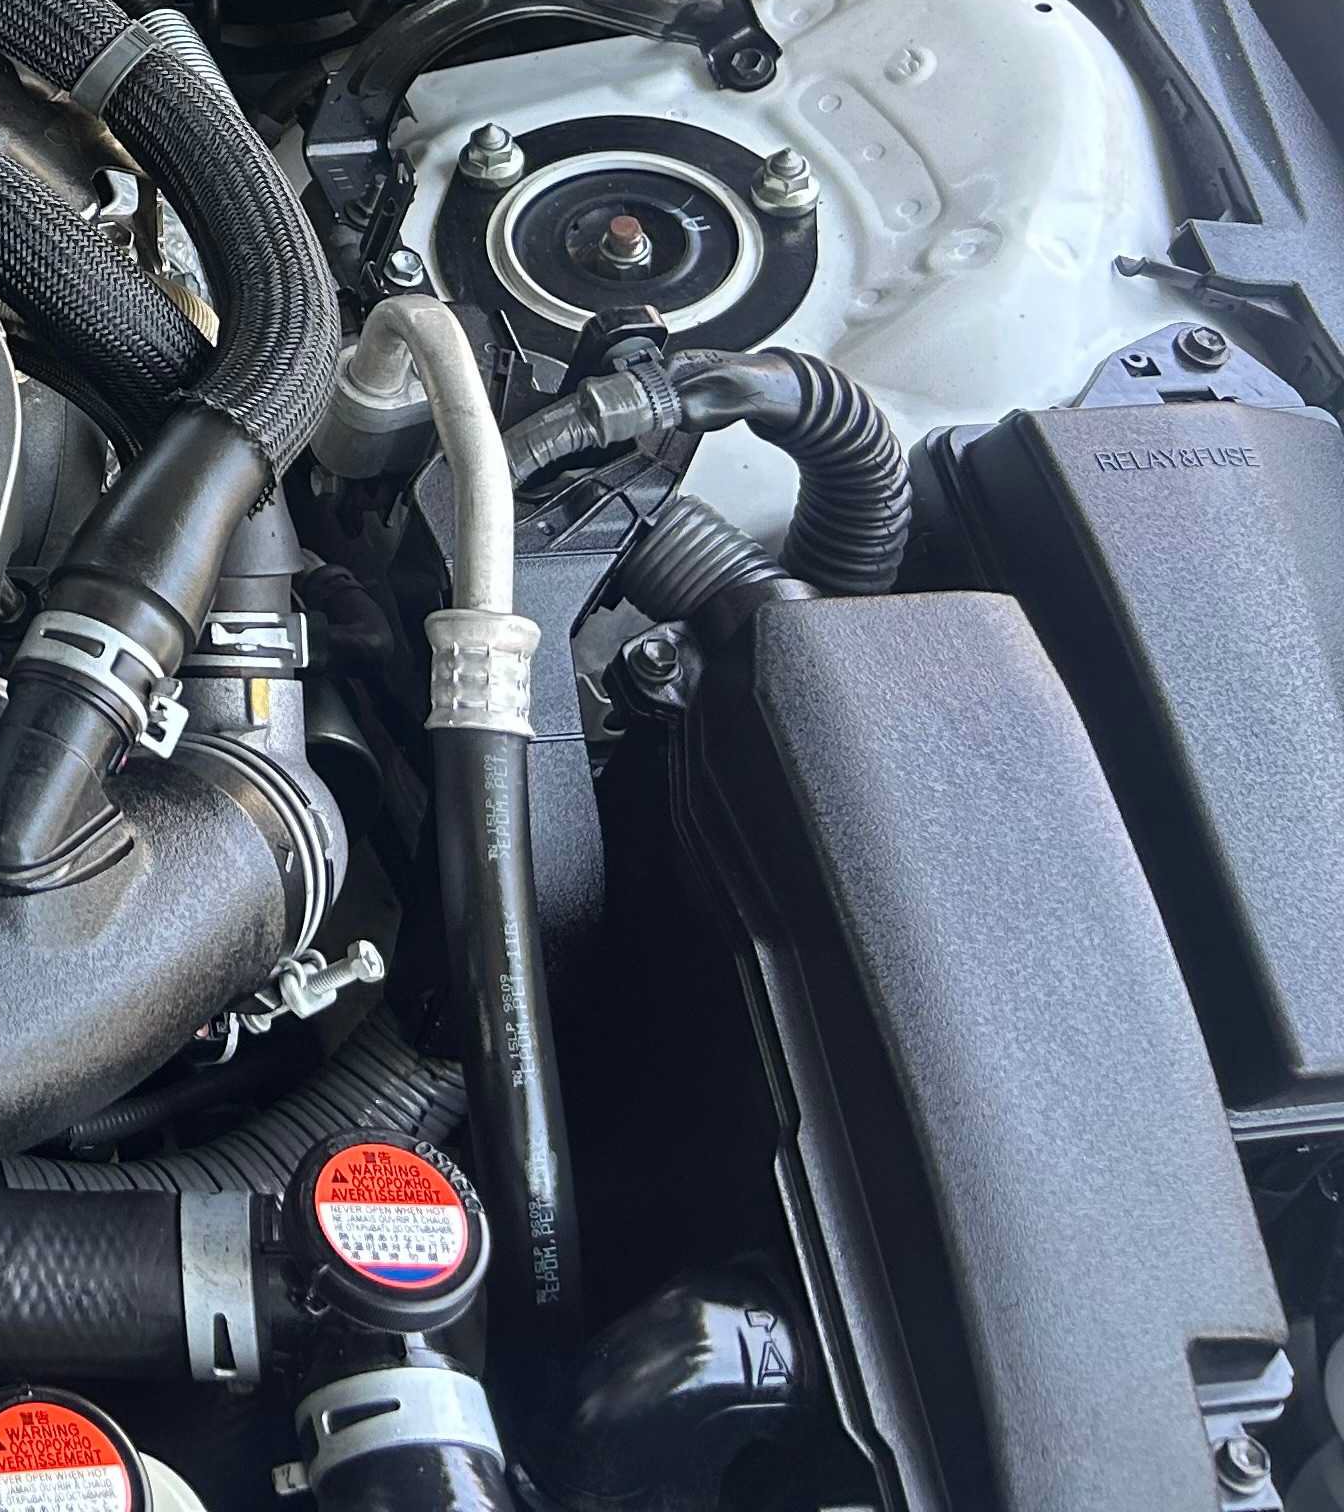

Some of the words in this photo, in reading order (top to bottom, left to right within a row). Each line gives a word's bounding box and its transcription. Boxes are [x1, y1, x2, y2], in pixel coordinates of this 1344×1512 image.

[1094, 448, 1262, 472] RELAY&FUSE
[348, 1163, 420, 1177] WARNING
[352, 1176, 431, 1190] ОСТОРОЖНО
[332, 1188, 441, 1202] AVERTISSEMENT
[331, 1205, 362, 1214] NEVER
[366, 1206, 391, 1214] OPEN
[395, 1207, 422, 1215] WHEN
[426, 1207, 444, 1215] HOT
[5, 1422, 80, 1439] WARNING
[10, 1436, 91, 1455] ОСТОРОЖНО
[25, 1472, 52, 1483] OPEN
[56, 1470, 84, 1481] WHEN
[87, 1468, 107, 1478] HOT
